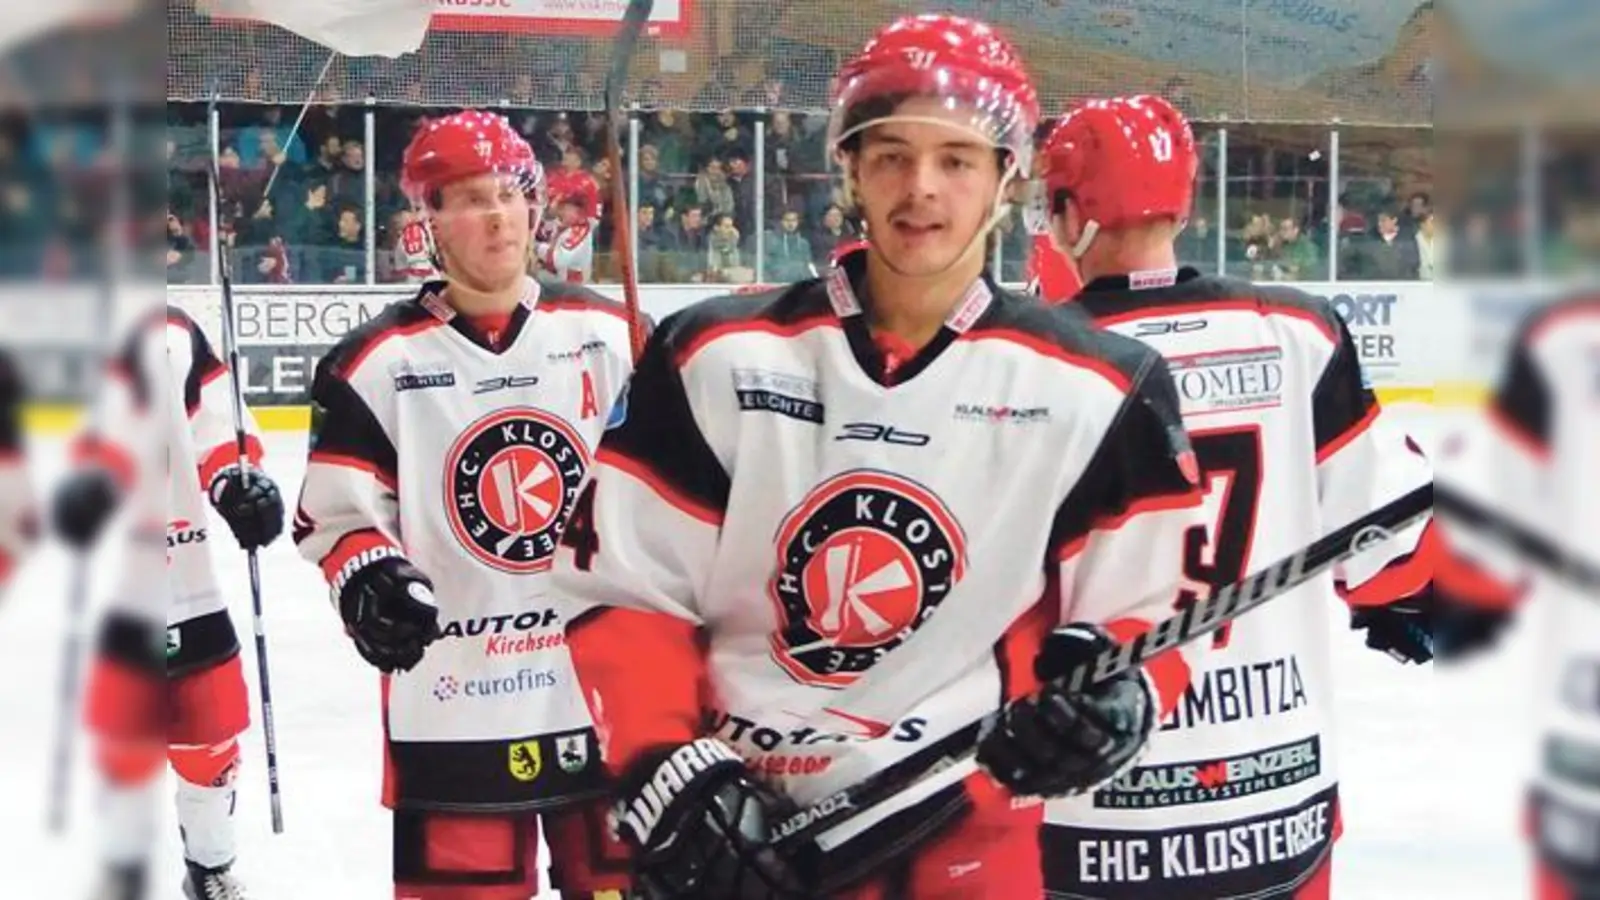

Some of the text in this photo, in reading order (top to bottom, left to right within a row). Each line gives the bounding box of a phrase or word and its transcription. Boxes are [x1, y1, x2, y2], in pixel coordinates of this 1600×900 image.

[580, 370, 598, 420] A
[464, 669, 557, 696] eurofins
[1079, 801, 1330, 883] EHC KLOSTERSEE
